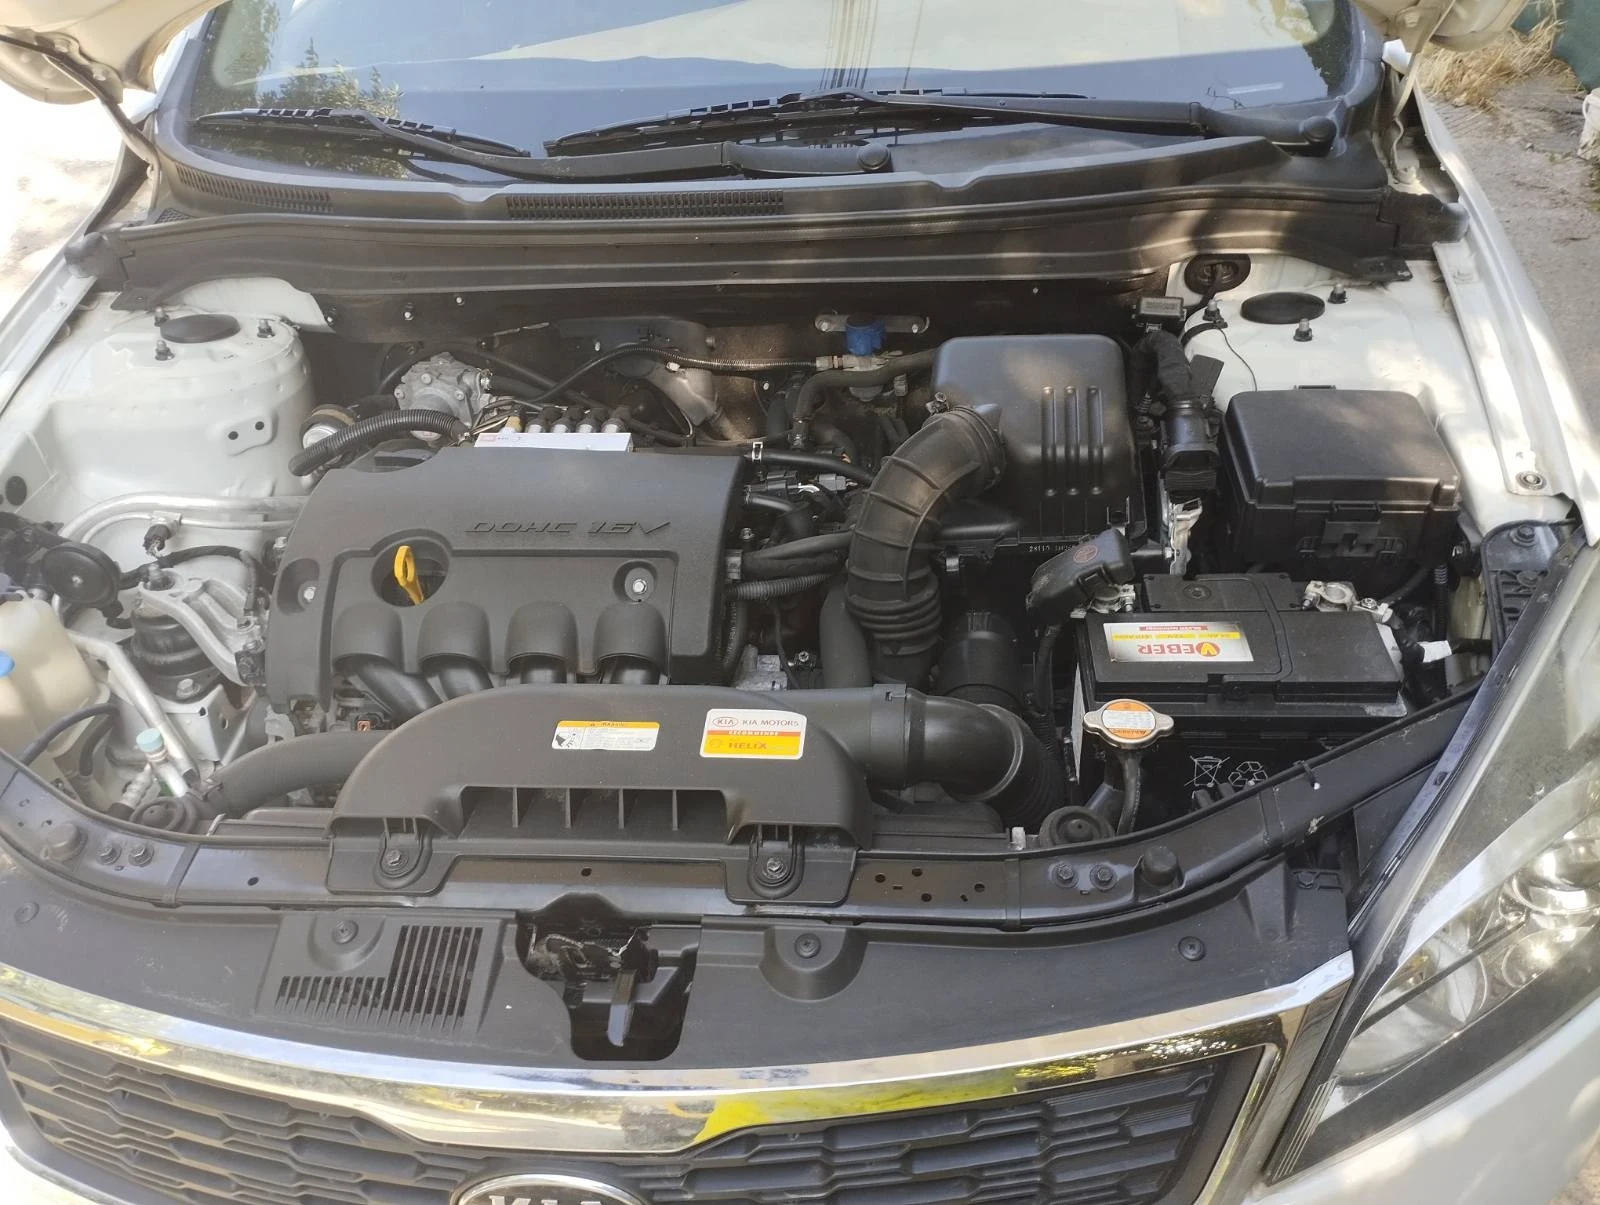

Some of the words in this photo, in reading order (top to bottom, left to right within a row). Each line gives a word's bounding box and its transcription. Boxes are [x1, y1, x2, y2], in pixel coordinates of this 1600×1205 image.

[464, 521, 577, 534] DOHC
[587, 521, 671, 535] 16V
[760, 719, 799, 727] MOTORS
[728, 742, 768, 750] HELIX
